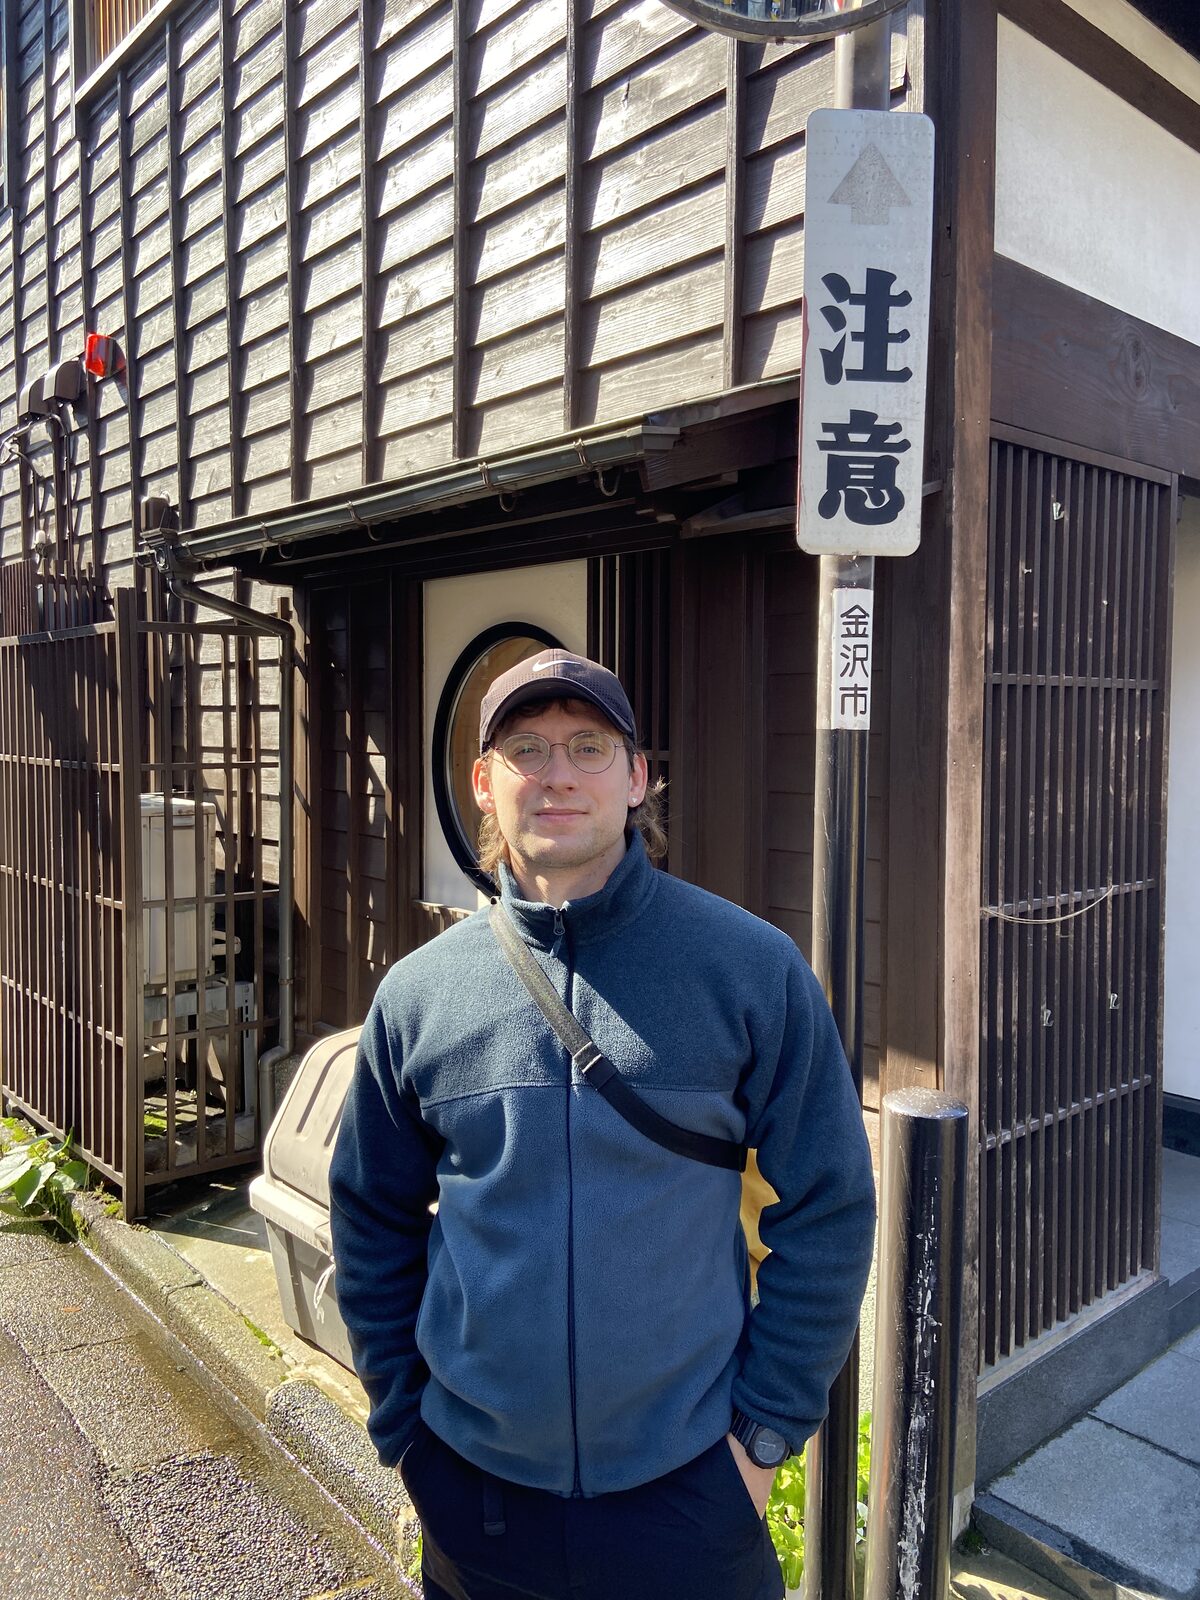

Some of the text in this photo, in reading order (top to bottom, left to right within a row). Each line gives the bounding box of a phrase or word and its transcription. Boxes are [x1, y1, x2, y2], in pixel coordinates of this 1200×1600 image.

[816, 267, 913, 526] 注意
[838, 603, 870, 717] 金沢市
